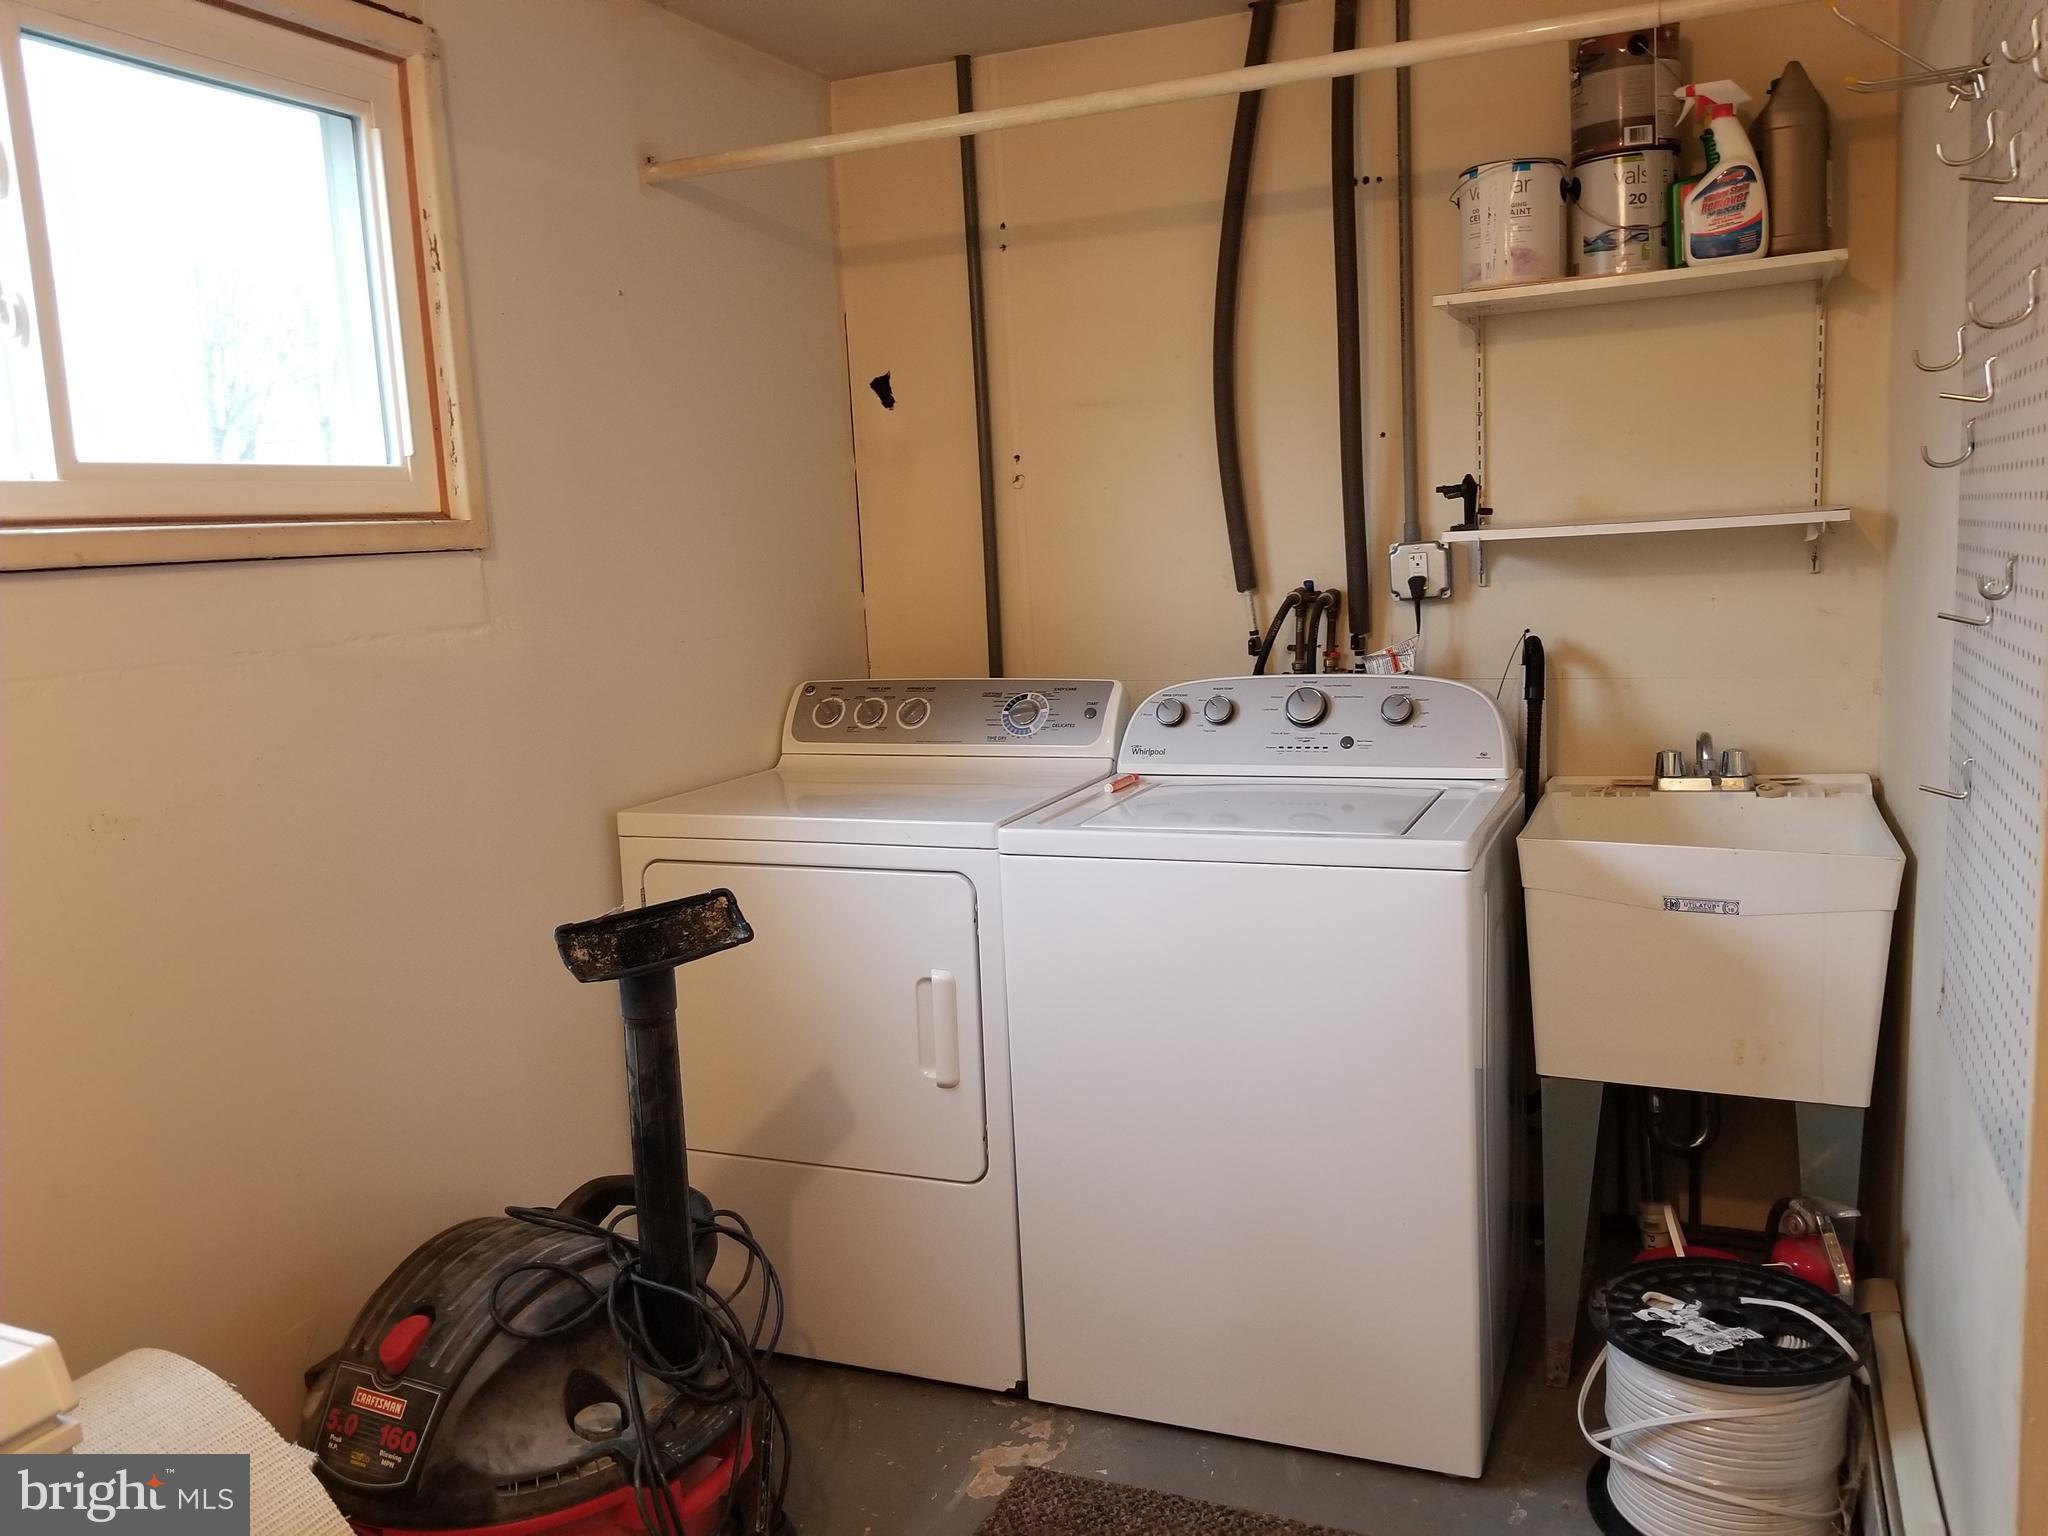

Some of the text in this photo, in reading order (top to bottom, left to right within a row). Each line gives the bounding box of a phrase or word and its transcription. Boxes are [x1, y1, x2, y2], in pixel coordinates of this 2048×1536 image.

[1614, 164, 1648, 185] vals
[1628, 192, 1648, 205] 20
[1701, 191, 1749, 214] Remover
[1510, 207, 1532, 216] AINT
[1131, 747, 1166, 757] Whirlpool
[356, 1392, 403, 1415] CRAFTSMAN
[325, 1407, 360, 1437] 5.0
[378, 1423, 417, 1454] 160
[379, 1449, 402, 1463] Blowing
[380, 1458, 395, 1469] MPH
